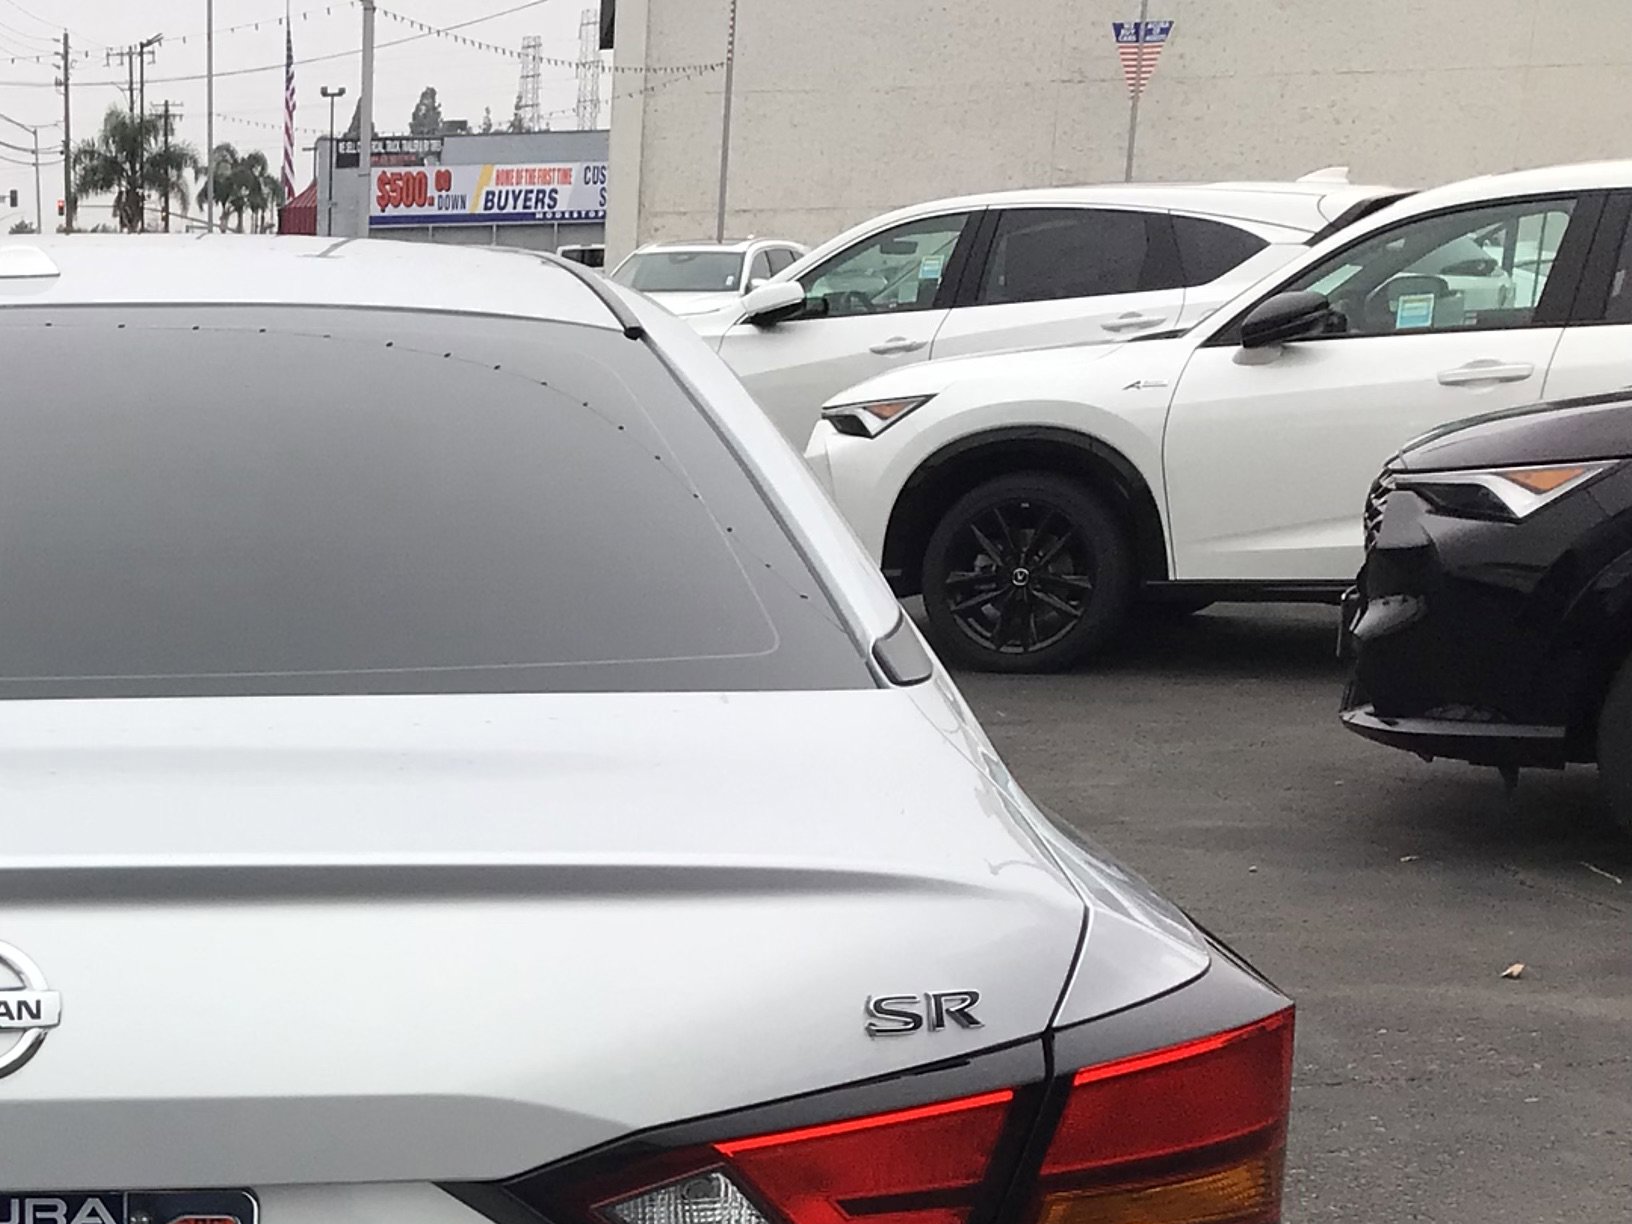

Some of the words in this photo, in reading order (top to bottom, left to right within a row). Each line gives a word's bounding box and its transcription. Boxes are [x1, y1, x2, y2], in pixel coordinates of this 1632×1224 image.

[437, 194, 467, 211] DOWN
[483, 188, 559, 211] BUYERS
[866, 988, 985, 1038] SR
